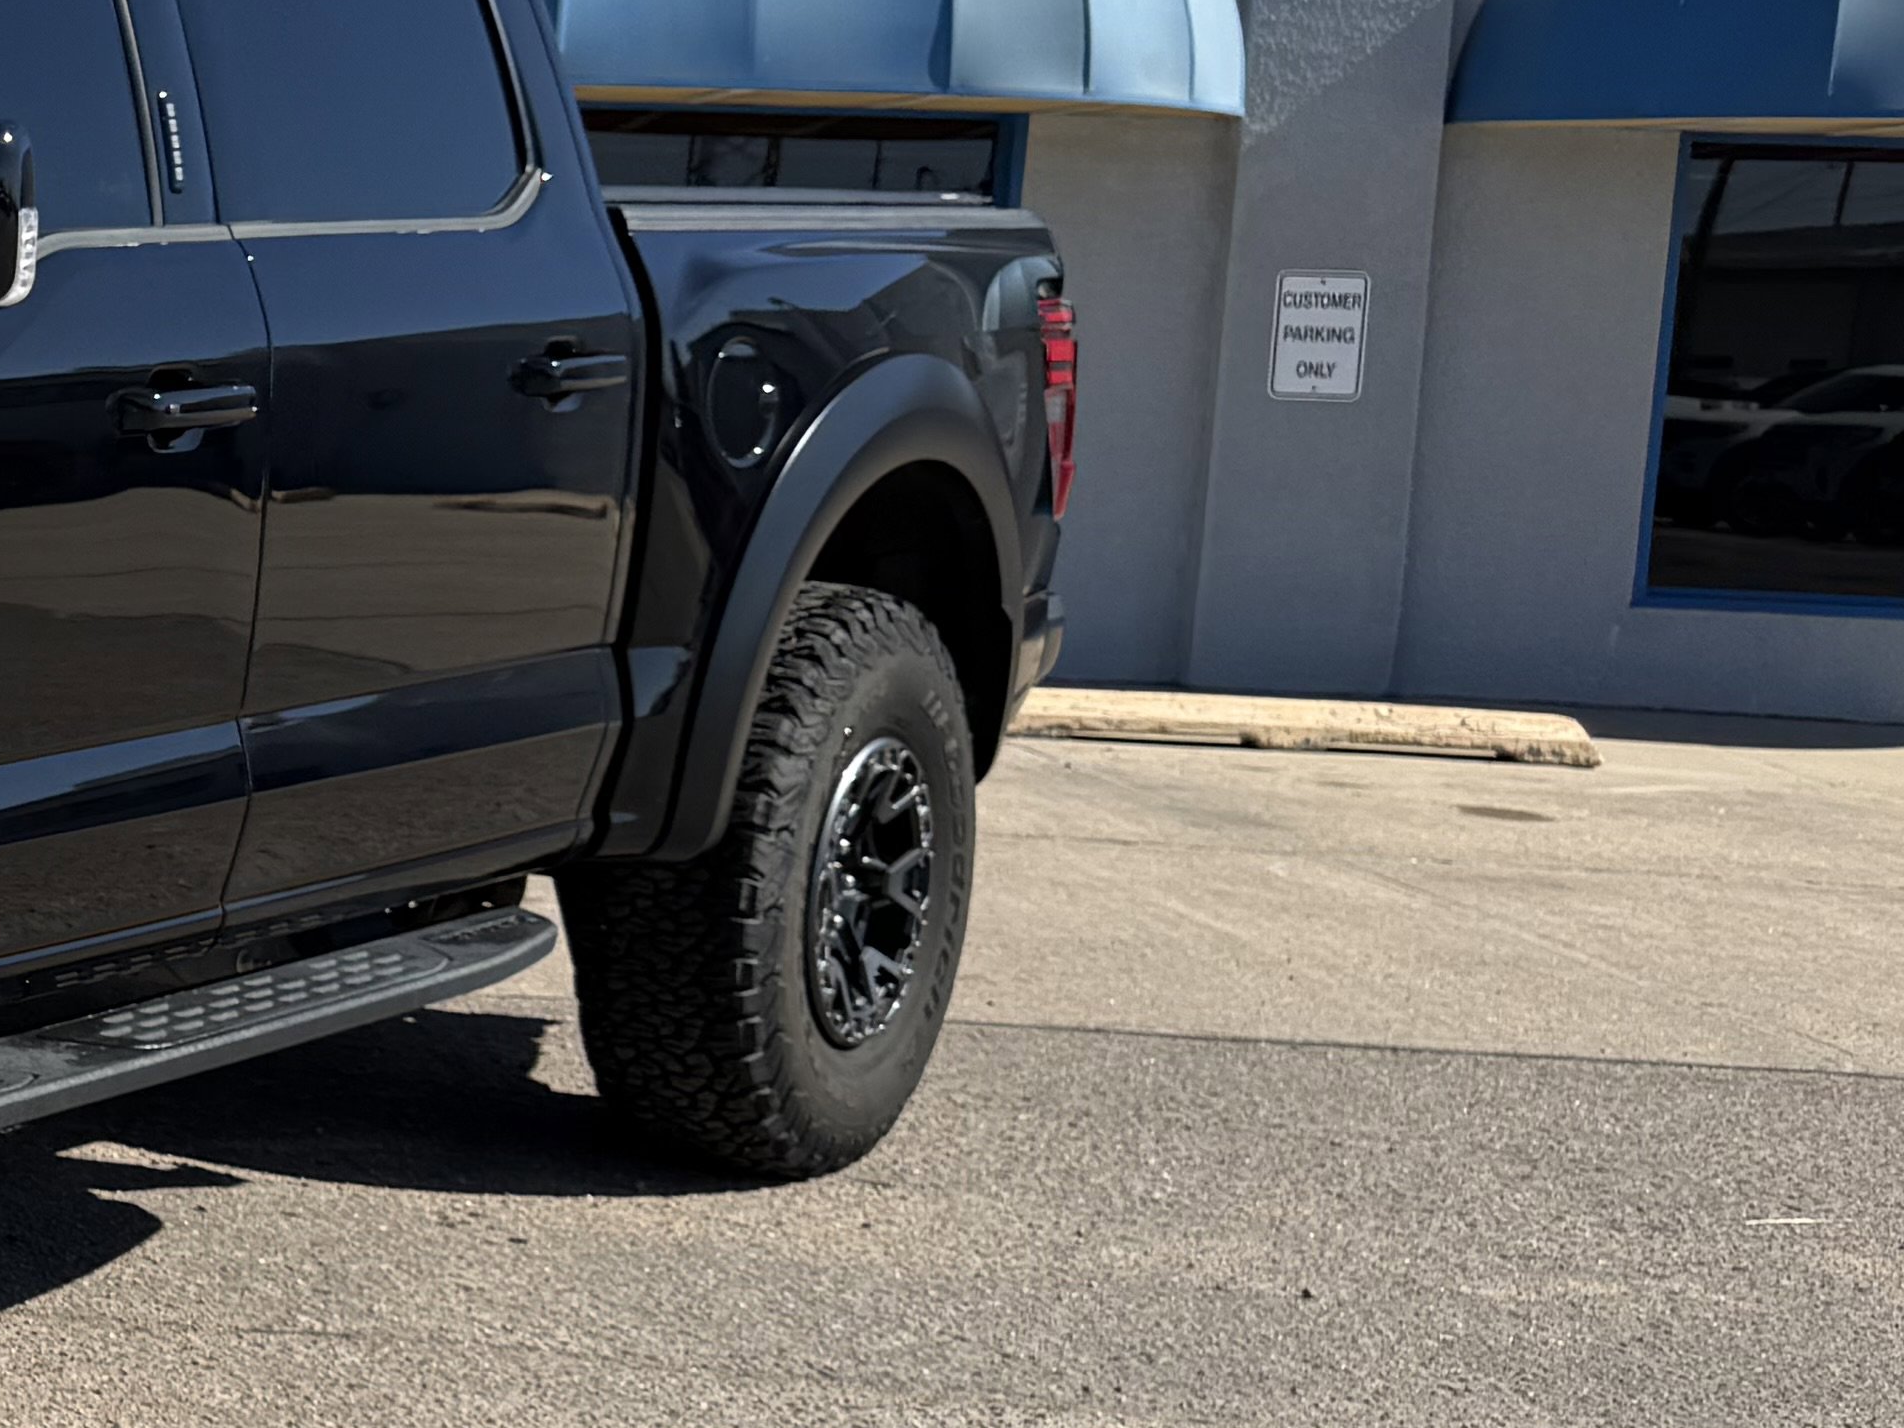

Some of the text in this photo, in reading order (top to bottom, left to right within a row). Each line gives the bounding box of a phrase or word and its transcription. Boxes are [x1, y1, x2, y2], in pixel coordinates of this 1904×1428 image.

[1282, 290, 1362, 310] CUSTOMER
[1282, 324, 1356, 344] PARKING
[1295, 359, 1336, 379] ONLY
